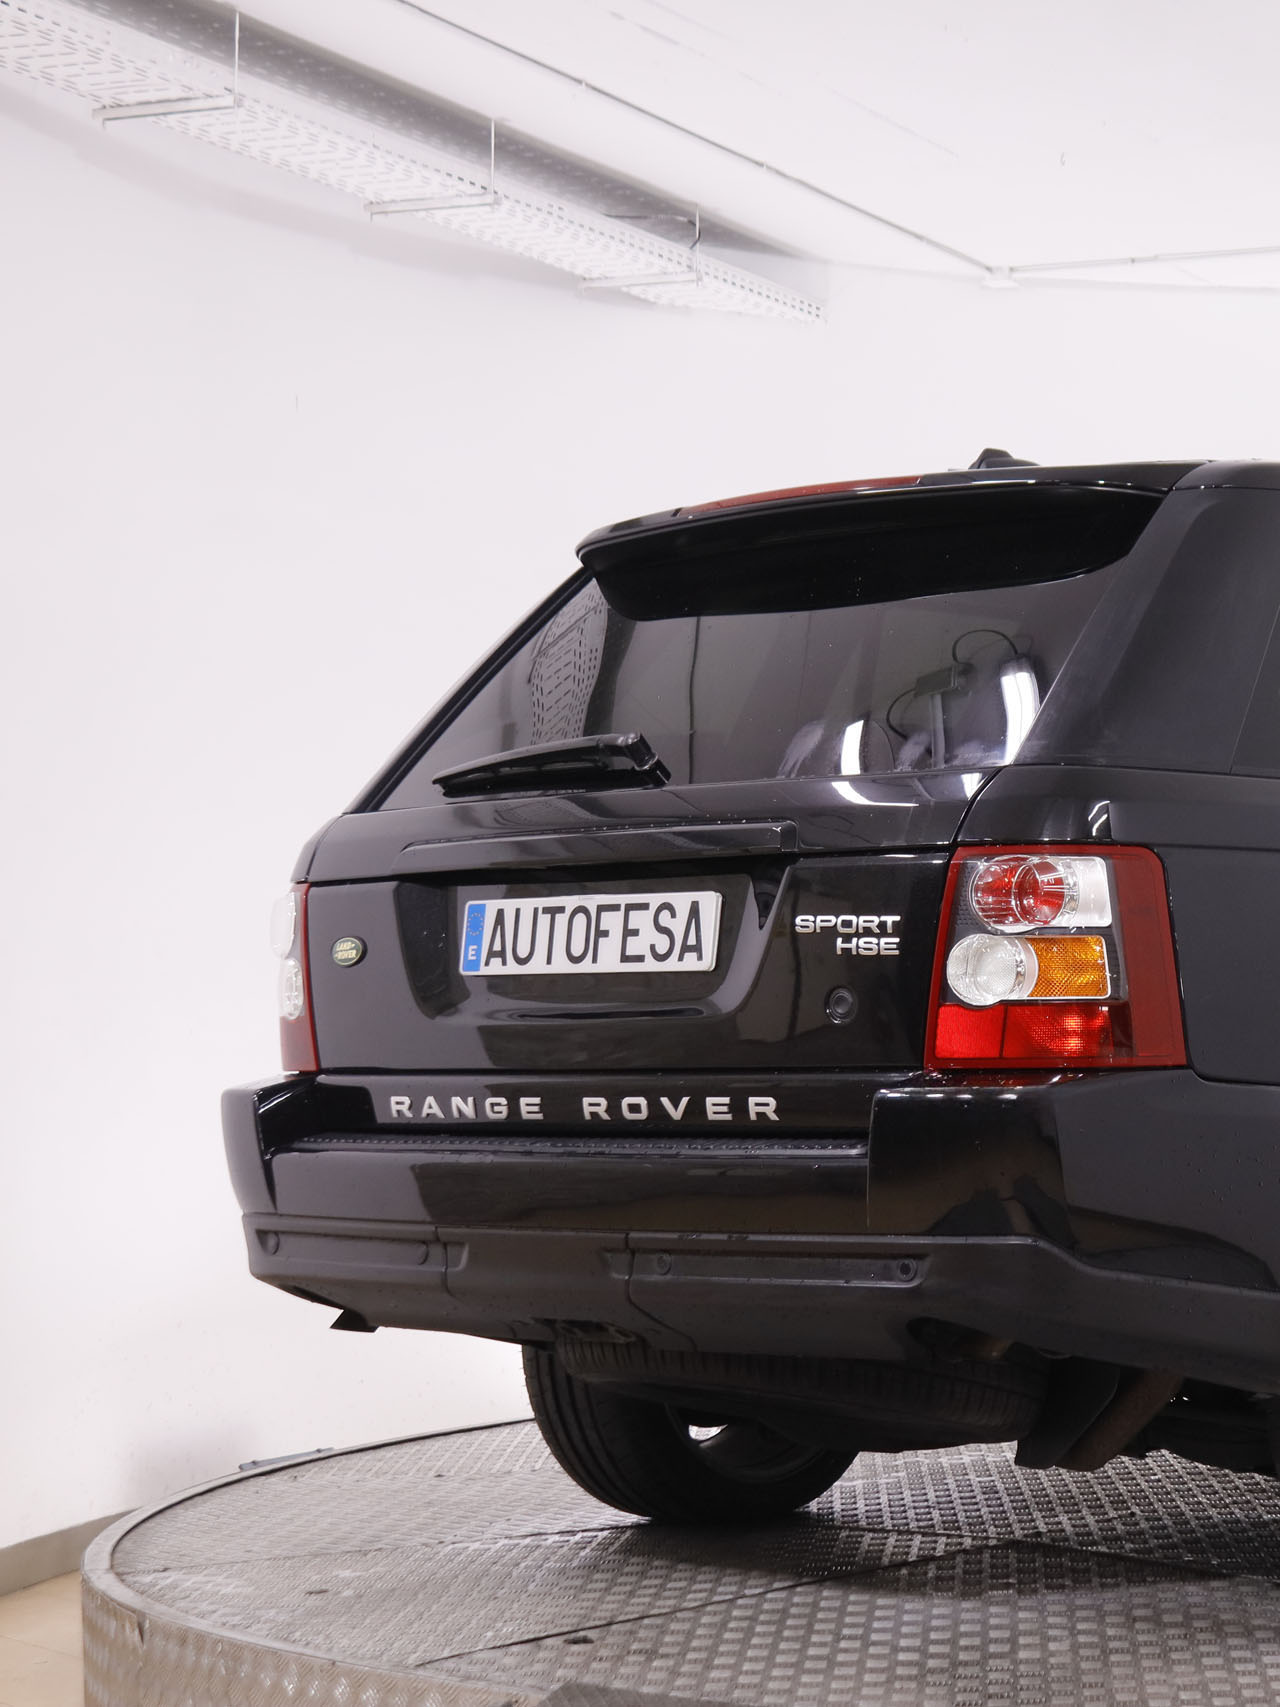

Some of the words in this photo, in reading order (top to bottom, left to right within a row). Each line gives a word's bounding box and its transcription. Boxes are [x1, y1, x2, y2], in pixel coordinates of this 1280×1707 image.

[795, 915, 901, 933] SPORT
[484, 900, 703, 967] AUTOFESA
[467, 945, 478, 961] E
[836, 937, 900, 955] HSE
[390, 1095, 544, 1120] RANGE
[582, 1096, 780, 1121] ROVER
